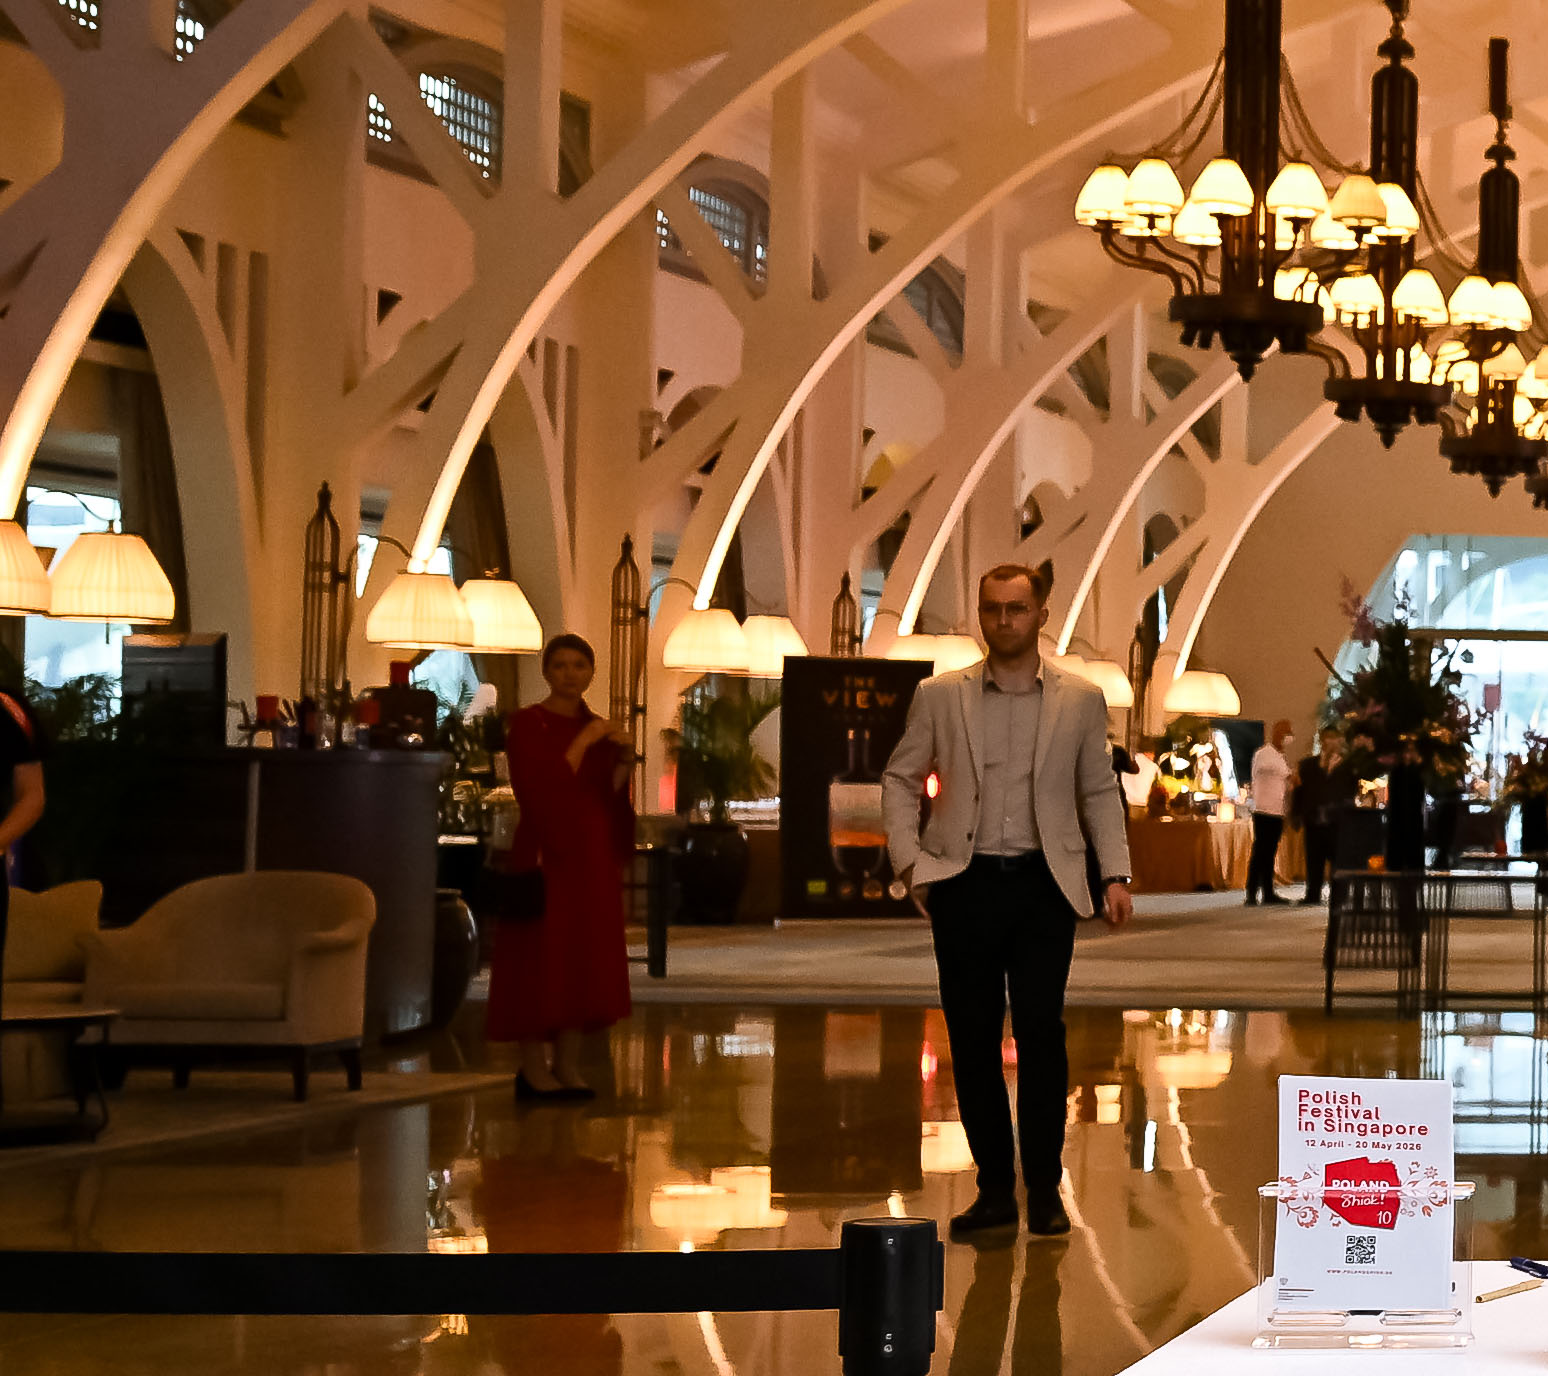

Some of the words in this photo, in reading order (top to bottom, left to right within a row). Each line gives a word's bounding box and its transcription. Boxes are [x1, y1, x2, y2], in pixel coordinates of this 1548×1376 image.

[823, 690, 897, 709] VIEW
[1298, 1090, 1362, 1105] Polish
[1298, 1104, 1380, 1120] Festival
[1299, 1118, 1314, 1131] in
[1324, 1118, 1428, 1137] Singapore
[1320, 1140, 1344, 1148] April
[1372, 1142, 1392, 1150] May
[1332, 1179, 1389, 1193] POLAND
[1377, 1211, 1392, 1225] 10
